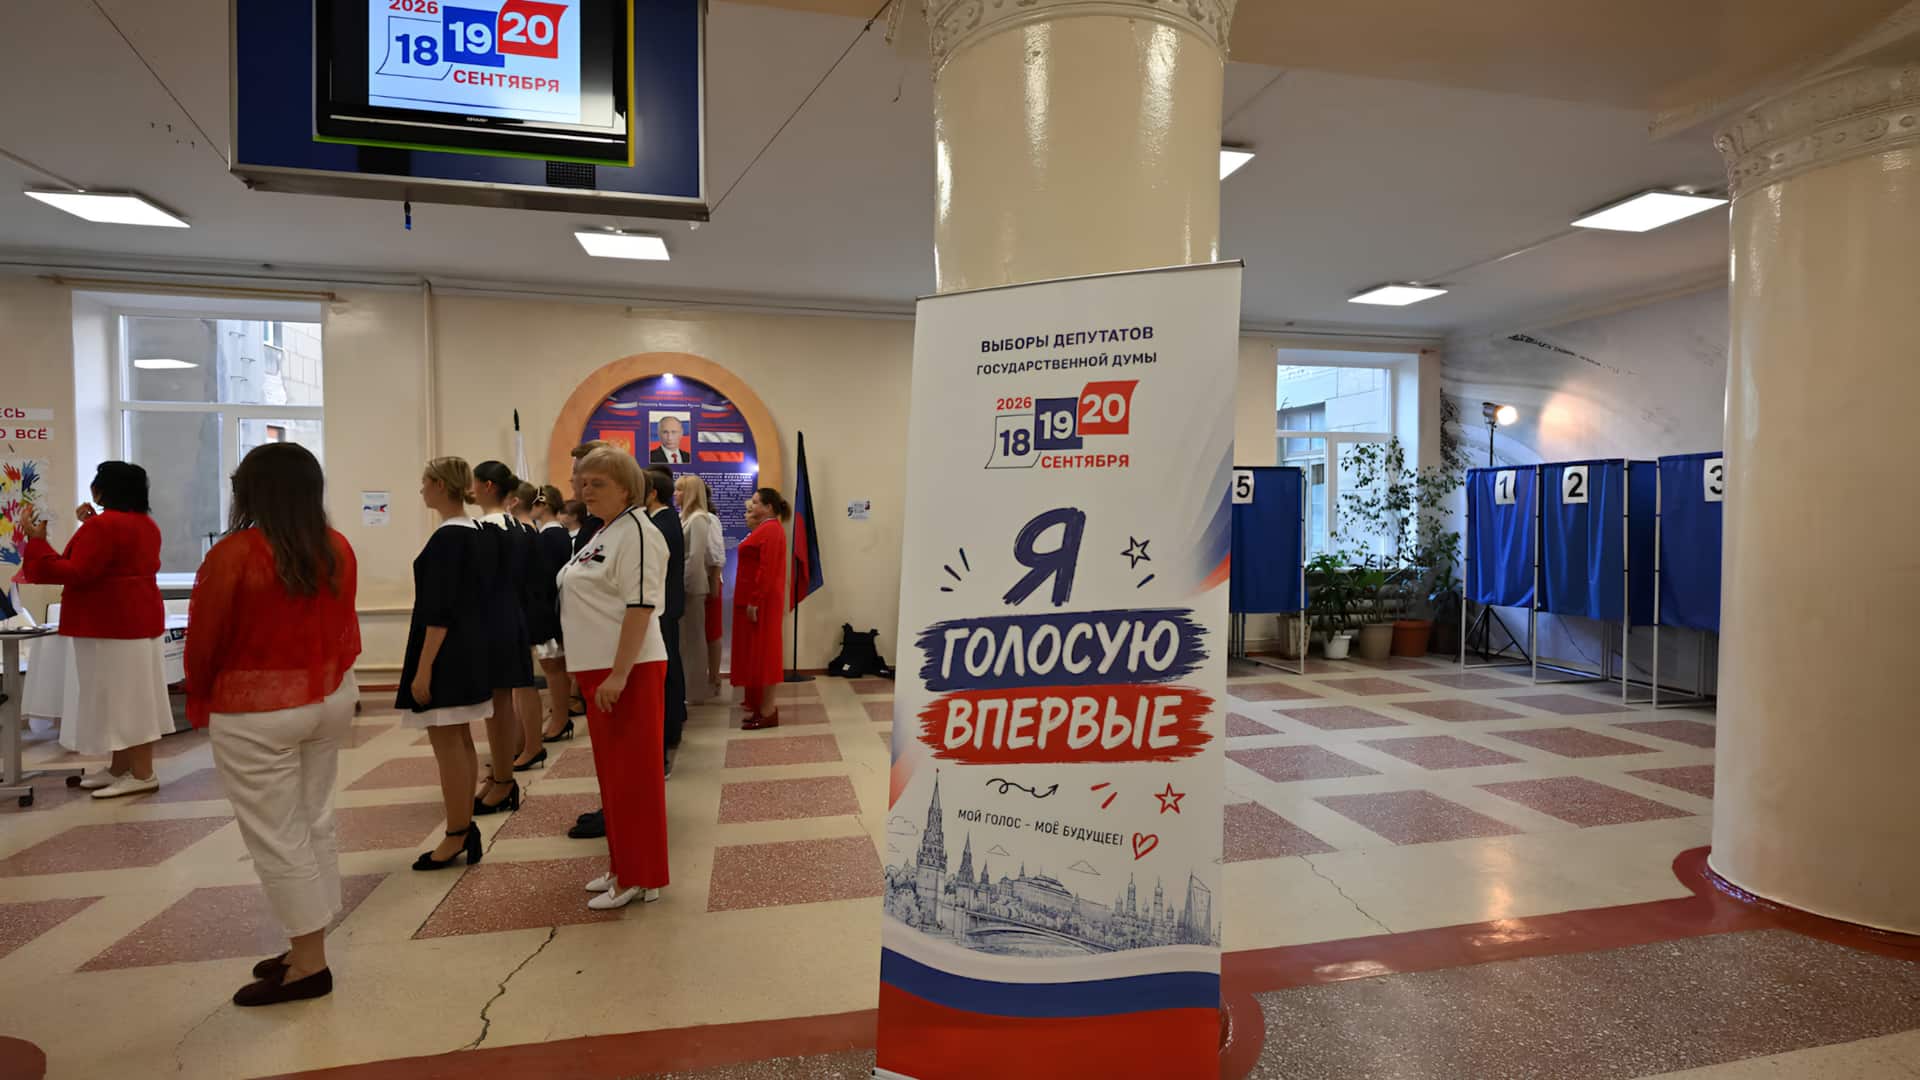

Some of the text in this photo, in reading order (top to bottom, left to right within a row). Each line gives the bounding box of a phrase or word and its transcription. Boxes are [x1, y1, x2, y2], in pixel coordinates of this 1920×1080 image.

[388, 0, 439, 14] 2026
[395, 11, 554, 66] 18 19 20
[453, 69, 559, 93] СЕНТЯБРЯ
[981, 326, 1154, 353] ВЫБОРЫ ДЕПУТАТОВ
[976, 352, 1157, 376] ГОСУДАРСТВЕННОЙ ДУМЫ
[0, 407, 26, 418] СЬ
[996, 397, 1032, 411] 2026
[15, 427, 48, 440] ВСЁ
[999, 393, 1127, 457] 18 19 20
[1041, 454, 1130, 469] СЕНТЯБРЯ
[1236, 475, 1250, 498] 5
[1499, 475, 1508, 500] 1
[1567, 471, 1585, 498] 2
[1709, 465, 1723, 495] 3
[1002, 507, 1086, 607] Я
[941, 619, 1180, 679] ГОЛОСУЮ
[943, 695, 1182, 750] ВПЕРВЫЕ
[958, 809, 982, 823] МОЙ
[984, 812, 1022, 829] ГОЛОС
[1034, 820, 1060, 836] МОЁ
[1062, 825, 1123, 846] БУДУЩЕЕ!
